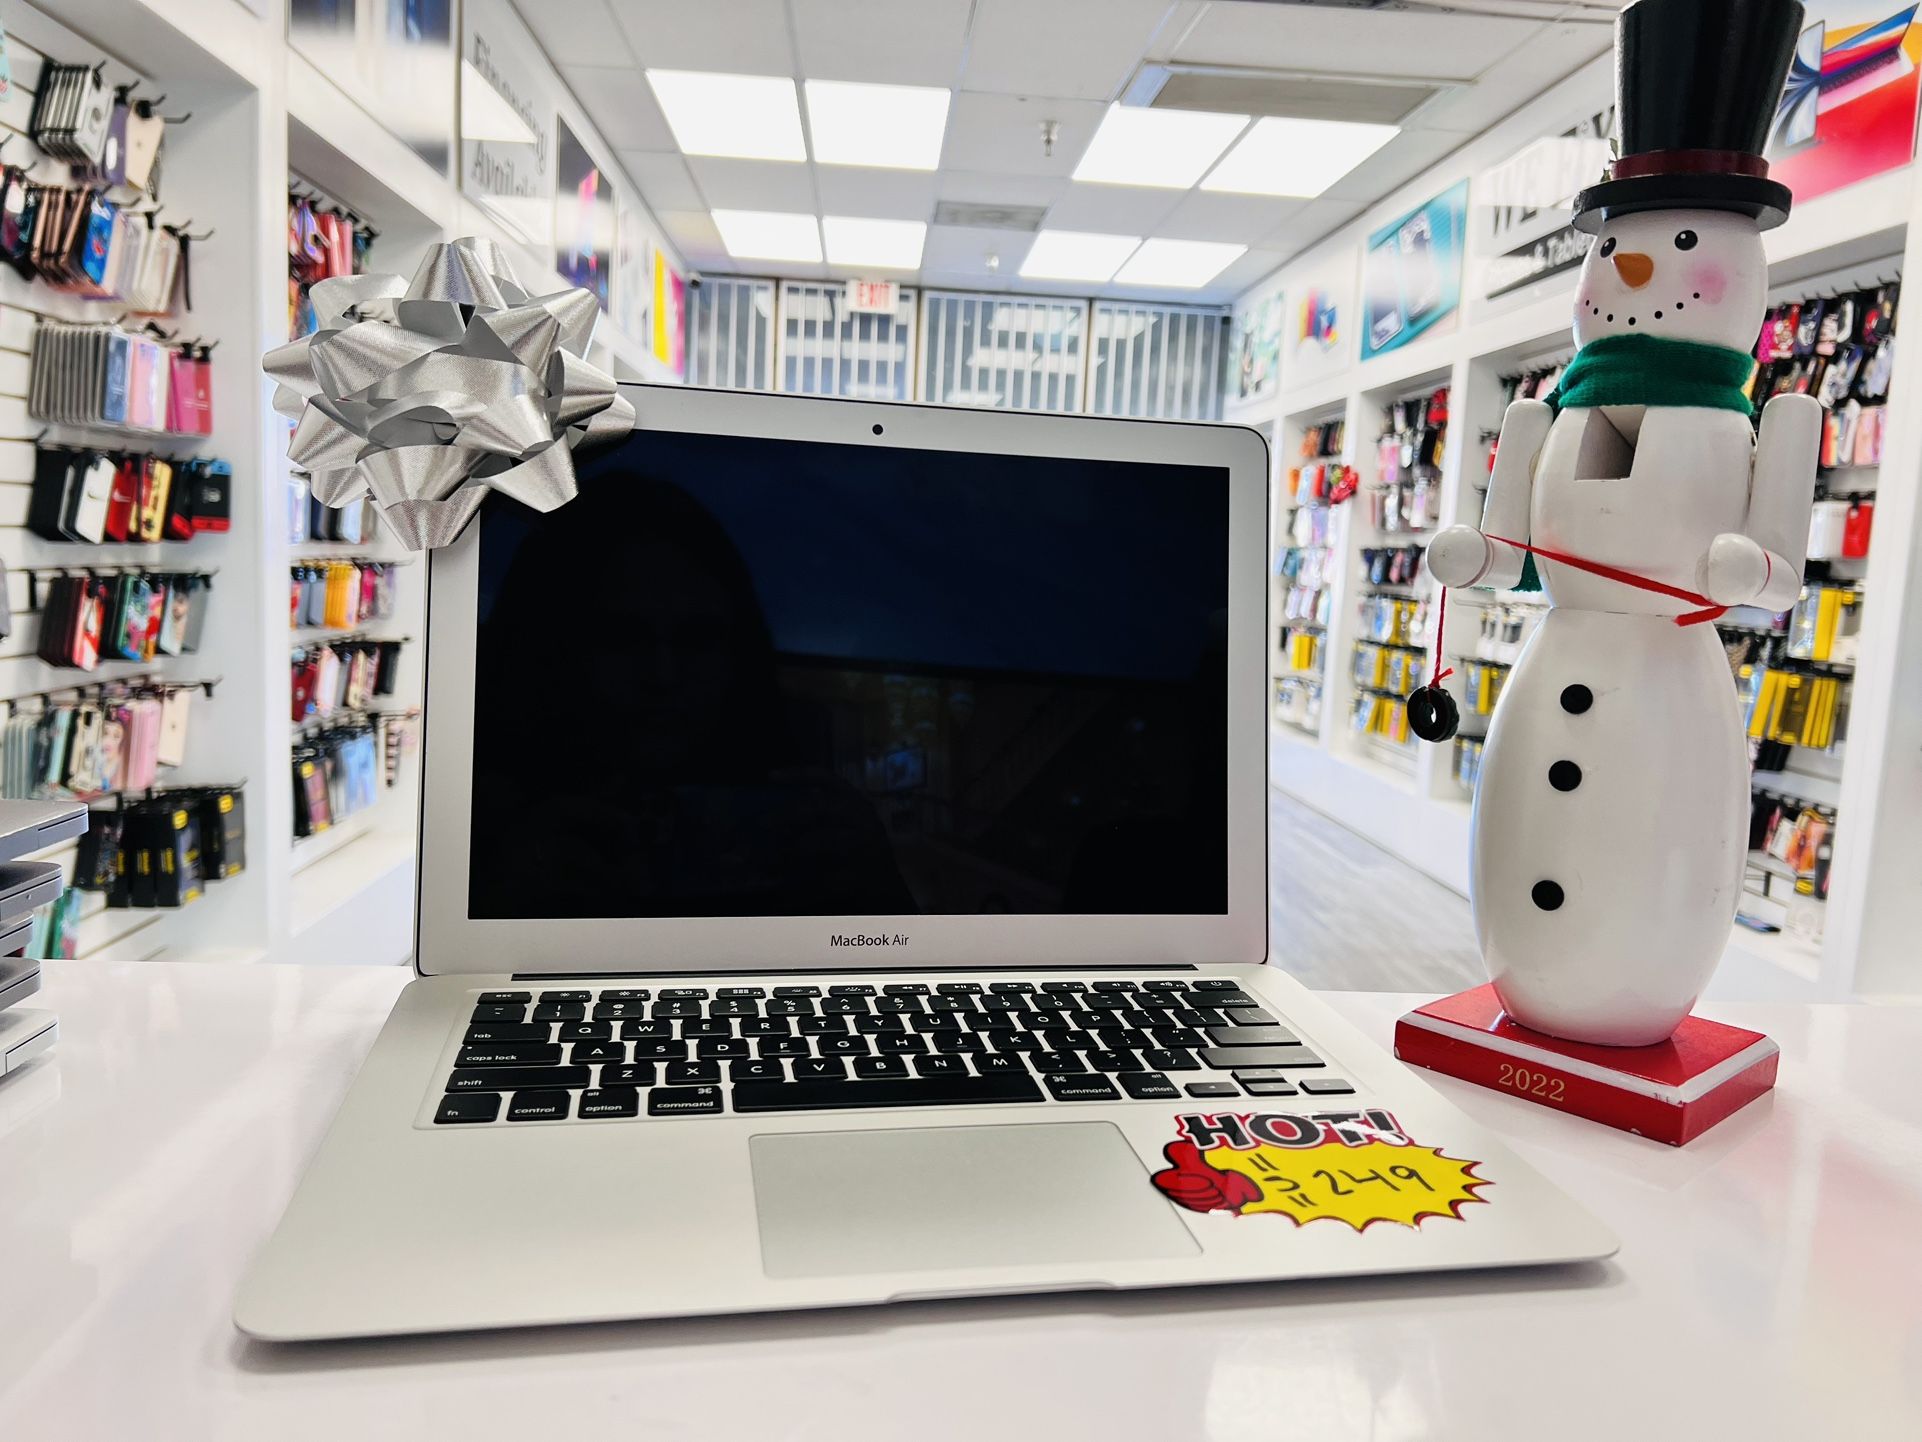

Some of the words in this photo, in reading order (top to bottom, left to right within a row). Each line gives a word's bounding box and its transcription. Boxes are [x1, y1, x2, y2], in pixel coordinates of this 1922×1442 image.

[856, 282, 891, 308] EXIT
[830, 934, 889, 947] MacBook
[892, 934, 909, 946] Air
[1037, 1015, 1049, 1023] O
[817, 1020, 827, 1028] T
[837, 1040, 850, 1048] G
[956, 1037, 963, 1045] J
[656, 1045, 666, 1053] S
[780, 1042, 788, 1050] F
[875, 1061, 887, 1070] B
[934, 1060, 948, 1068] N
[992, 1058, 1008, 1066] M
[686, 1067, 700, 1075] X
[750, 1065, 763, 1073] C
[812, 1063, 825, 1071] V
[621, 1070, 633, 1078] Z
[1498, 1063, 1565, 1102] 2022
[1061, 1087, 1112, 1095] command
[585, 1105, 622, 1113] option
[656, 1101, 714, 1109] command
[514, 1106, 555, 1114] control
[1178, 1109, 1408, 1150] HOT!
